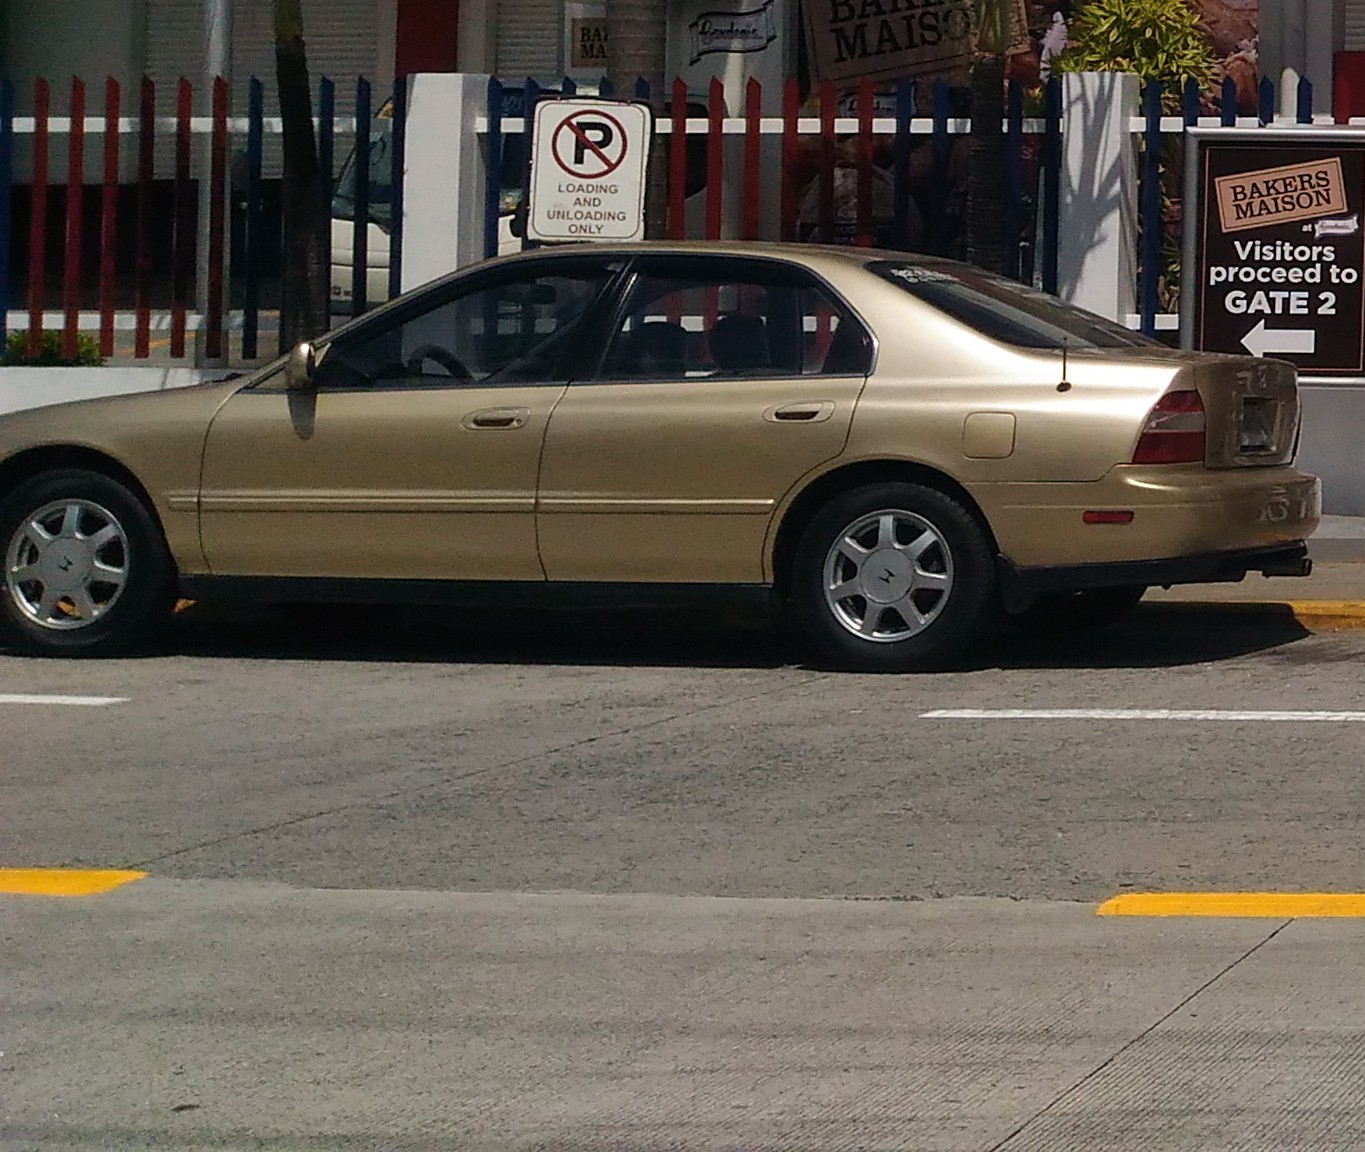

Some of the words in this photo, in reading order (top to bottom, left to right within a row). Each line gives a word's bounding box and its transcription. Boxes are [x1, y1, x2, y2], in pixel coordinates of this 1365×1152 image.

[830, 10, 972, 62] MAISO
[558, 183, 618, 194] LOADING
[1230, 171, 1330, 202] BAKERS
[573, 197, 601, 207] AND
[1233, 189, 1331, 220] MAISON
[547, 210, 626, 221] UNLOADING
[568, 224, 604, 234] ONLY
[1302, 224, 1312, 232] at
[1234, 240, 1335, 261] Visitors
[1210, 263, 1321, 285] proceed
[1330, 265, 1358, 283] to
[1225, 290, 1309, 314] GATE
[1317, 291, 1336, 315] 2
